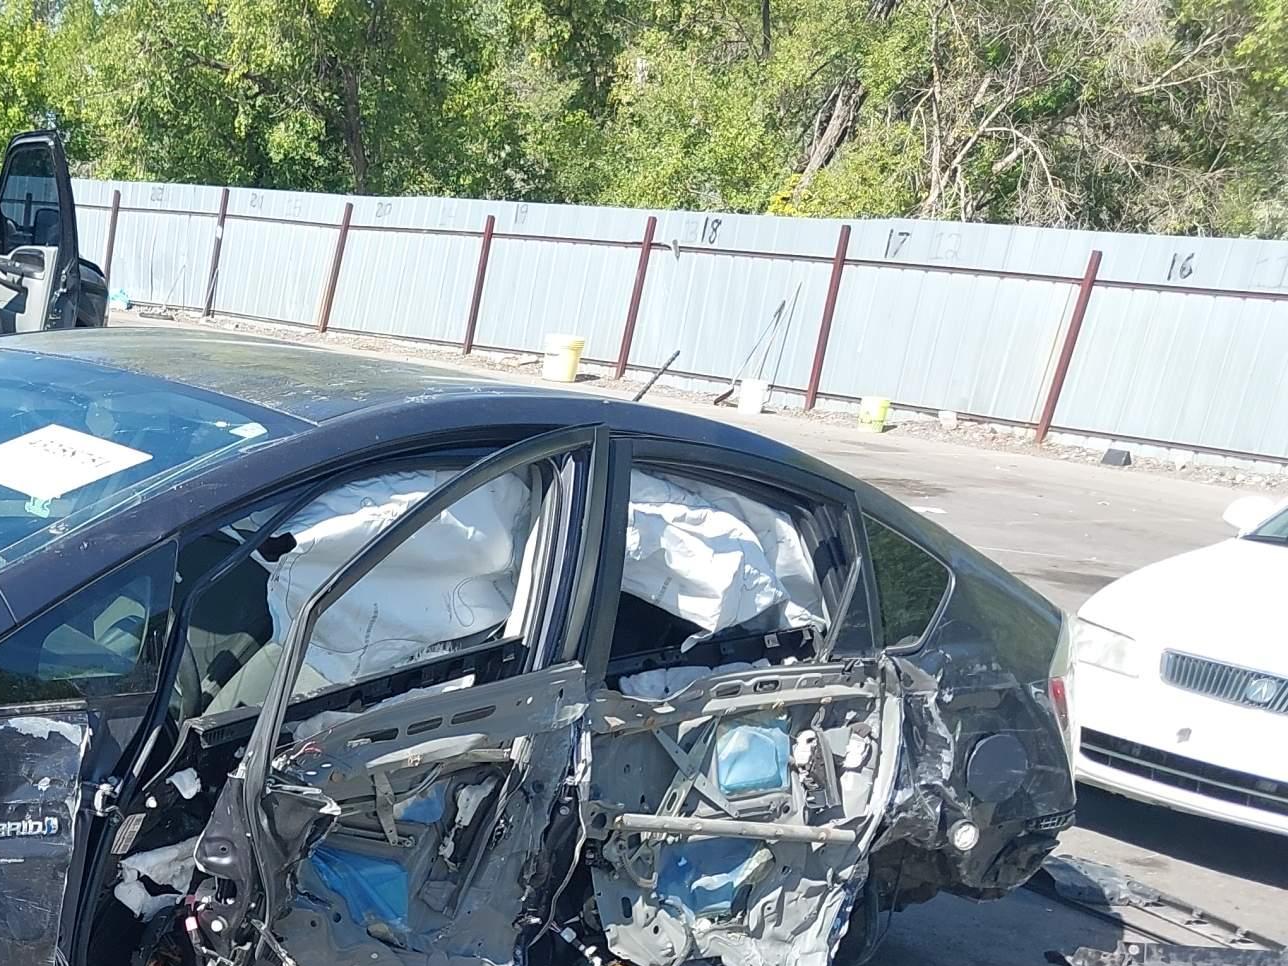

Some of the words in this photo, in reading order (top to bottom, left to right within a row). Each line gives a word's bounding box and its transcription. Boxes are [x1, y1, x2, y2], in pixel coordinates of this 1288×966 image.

[375, 202, 393, 218] 20
[514, 203, 529, 225] 19
[701, 216, 722, 244] 18
[884, 228, 911, 259] 17
[1166, 252, 1195, 281] 16
